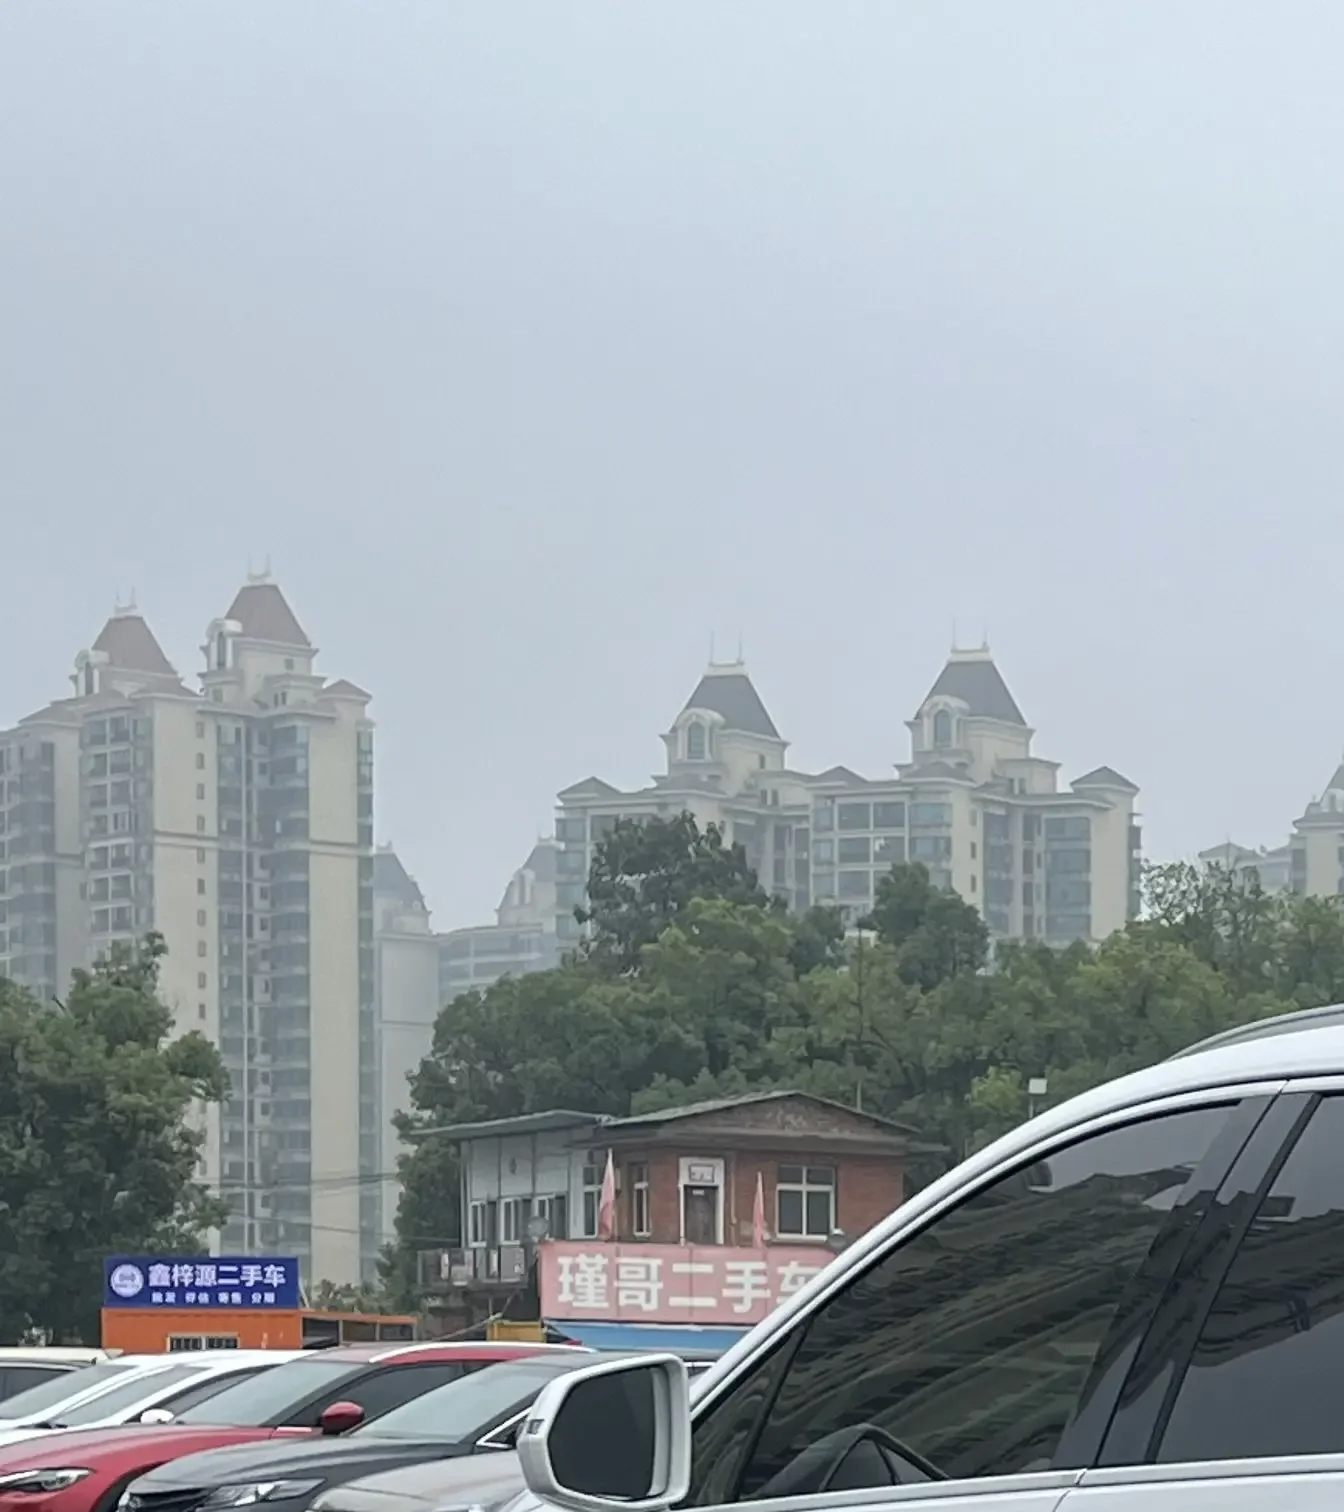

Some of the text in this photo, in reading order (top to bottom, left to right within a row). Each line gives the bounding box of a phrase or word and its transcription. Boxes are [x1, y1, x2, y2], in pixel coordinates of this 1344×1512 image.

[148, 1263, 286, 1288] 鑫梓源二手车
